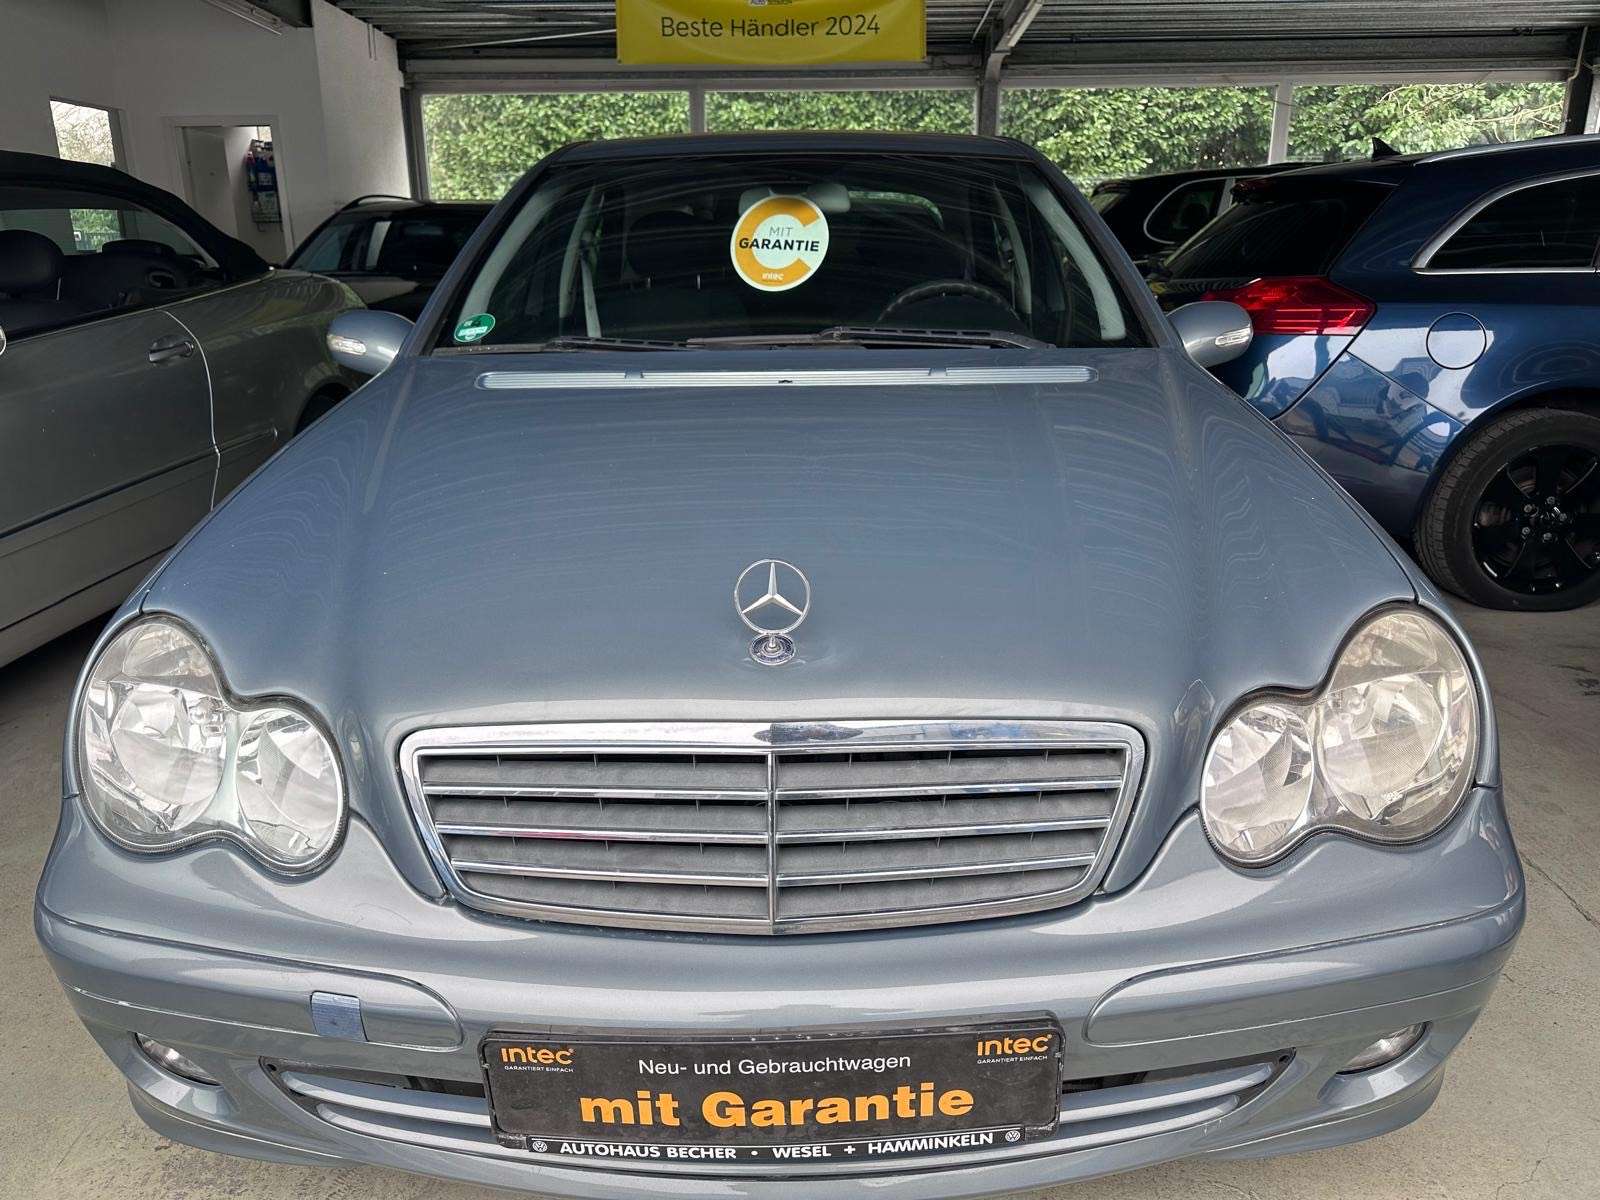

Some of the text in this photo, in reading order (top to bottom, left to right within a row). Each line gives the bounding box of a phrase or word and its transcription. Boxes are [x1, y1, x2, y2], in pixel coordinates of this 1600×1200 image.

[660, 14, 881, 37] Beste Händler 2024
[769, 226, 793, 237] MIT
[739, 238, 820, 252] GARANTIE
[638, 1055, 912, 1075] Neu- und Gebrauchtwagen
[580, 1082, 975, 1128] mit Garantie
[559, 1142, 661, 1157] AUTOHAUS
[666, 1147, 737, 1159] BECHER
[772, 1146, 832, 1159] WESEL
[867, 1132, 994, 1155] HAMMINKELN
